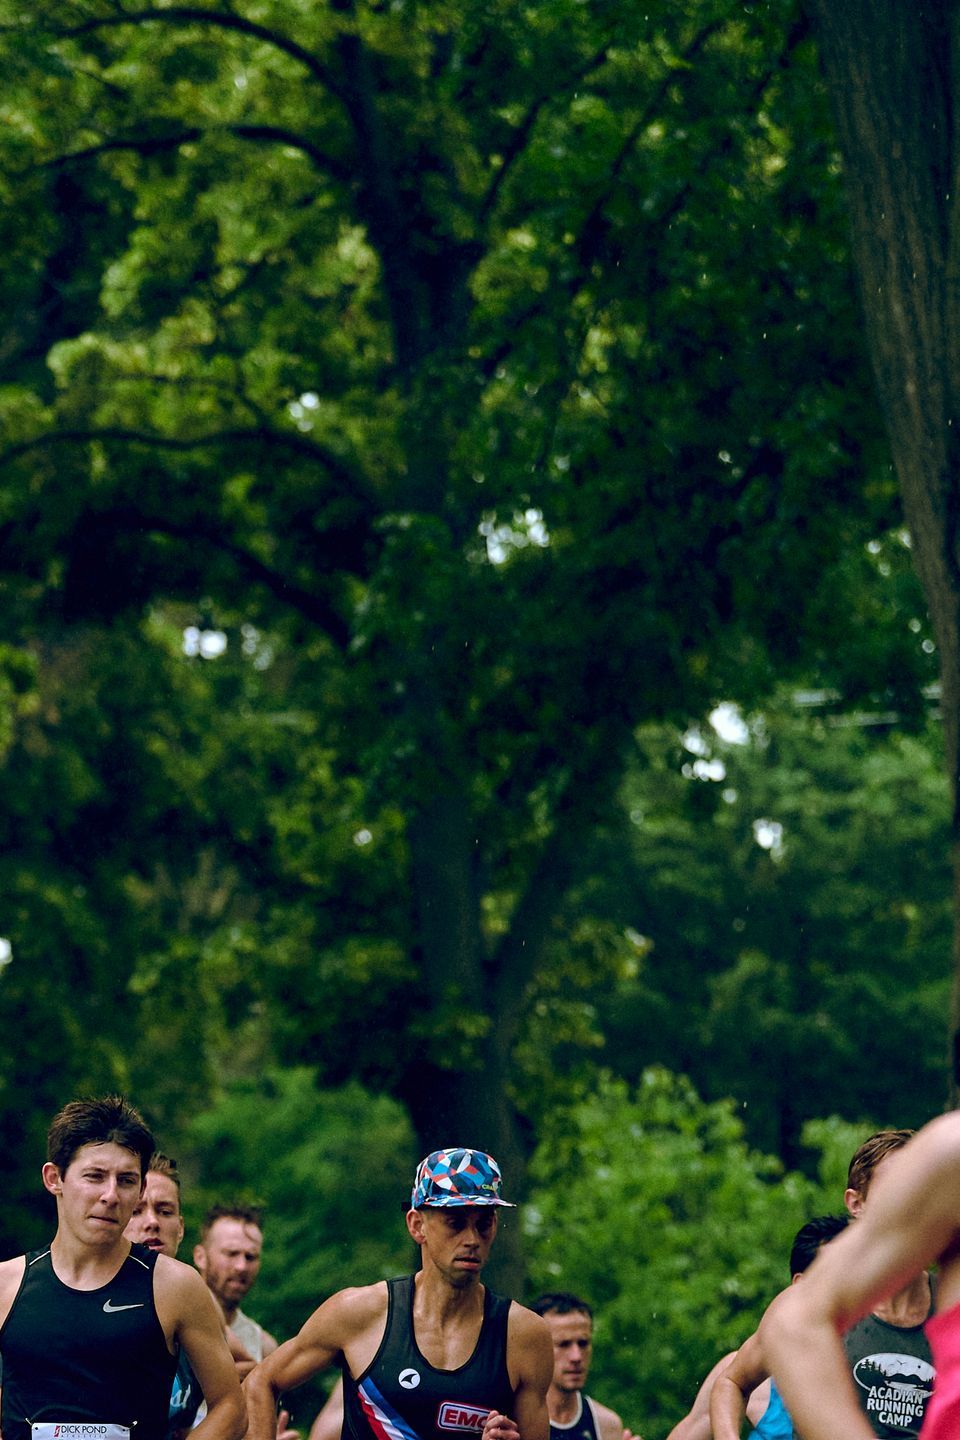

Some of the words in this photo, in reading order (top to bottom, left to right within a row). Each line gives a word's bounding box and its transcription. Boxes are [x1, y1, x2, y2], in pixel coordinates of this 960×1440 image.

[869, 1386, 923, 1405] ACADIAN
[867, 1398, 924, 1416] RUNNING
[878, 1411, 913, 1427] CAMP
[60, 1425, 80, 1434] DICK
[82, 1425, 107, 1434] POND
